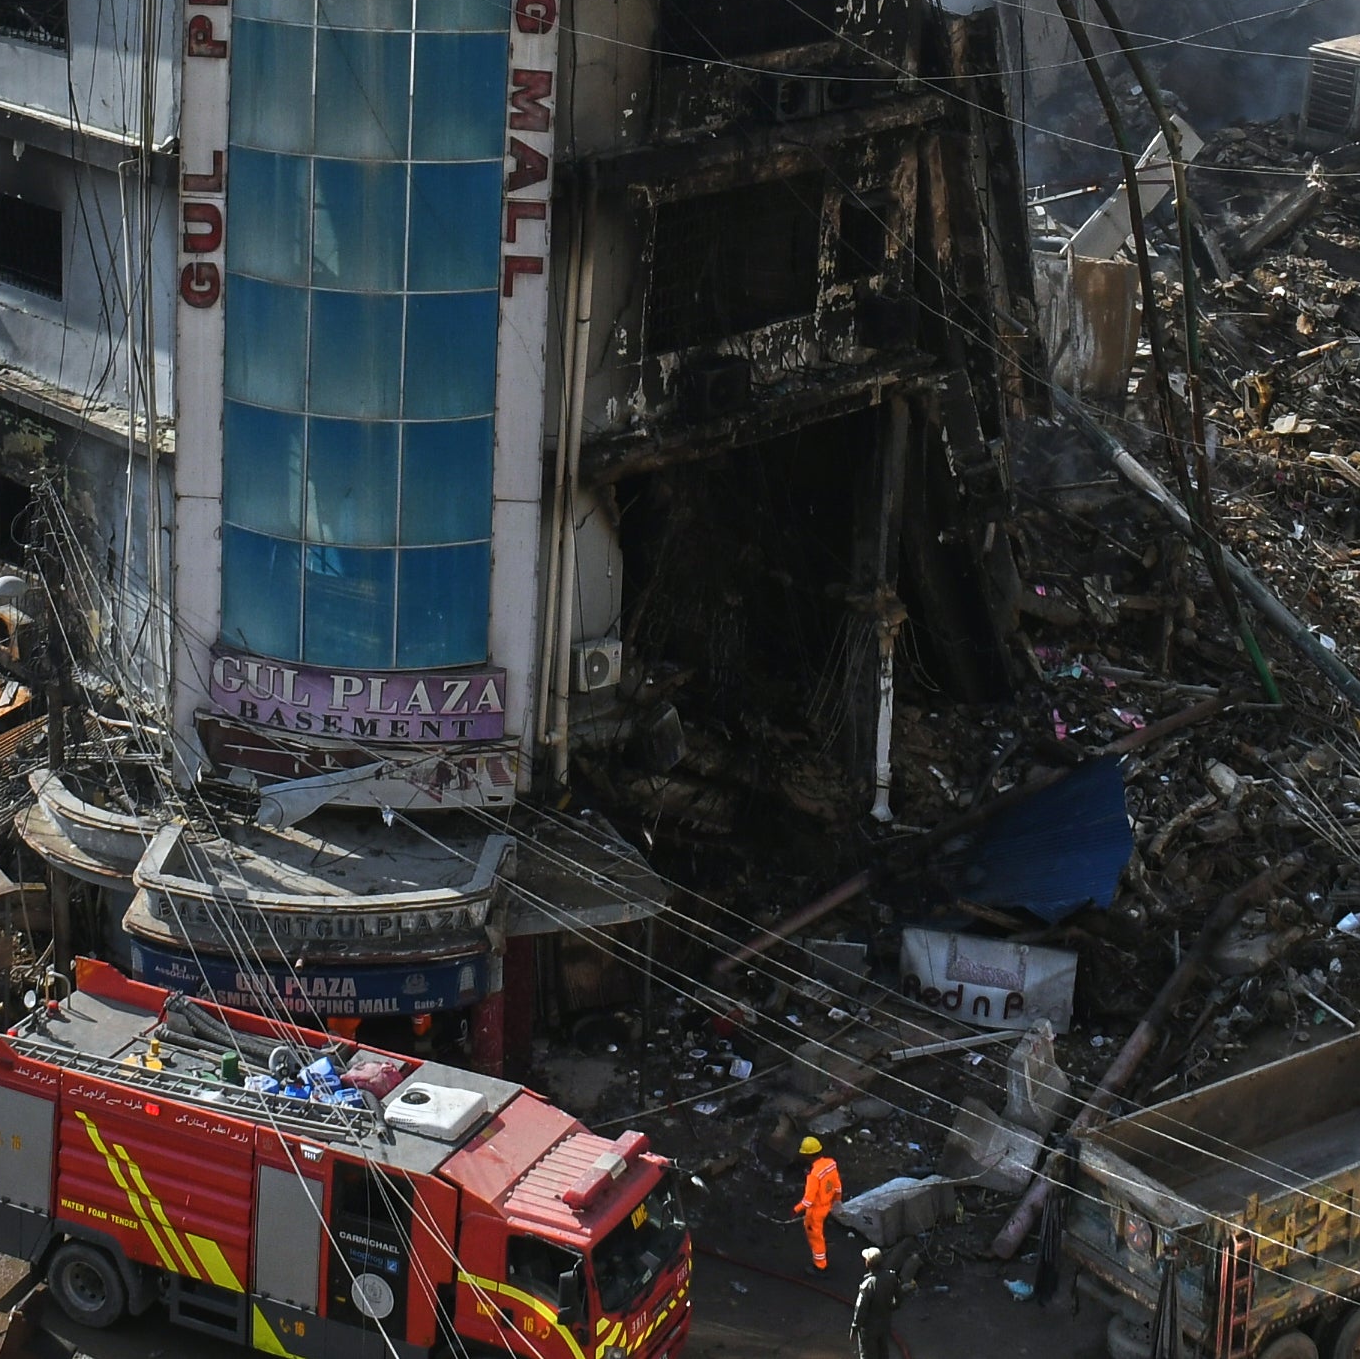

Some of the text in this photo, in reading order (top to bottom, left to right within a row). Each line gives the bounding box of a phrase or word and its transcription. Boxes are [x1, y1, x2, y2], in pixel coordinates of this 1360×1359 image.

[181, 150, 224, 309] GUL
[503, 69, 553, 298] MALL
[212, 656, 505, 715] GUL PLAZA
[238, 699, 474, 739] BASEMENT
[235, 972, 357, 997] GUL PLAZA
[272, 995, 355, 1014] SHOPPING
[358, 997, 400, 1014] MALL
[972, 995, 991, 1017] n
[60, 1198, 139, 1231] WATER FOAM TENDER
[339, 1230, 401, 1255] CARMICHAEL
[294, 1321, 305, 1337] 16
[523, 1316, 534, 1333] 16
